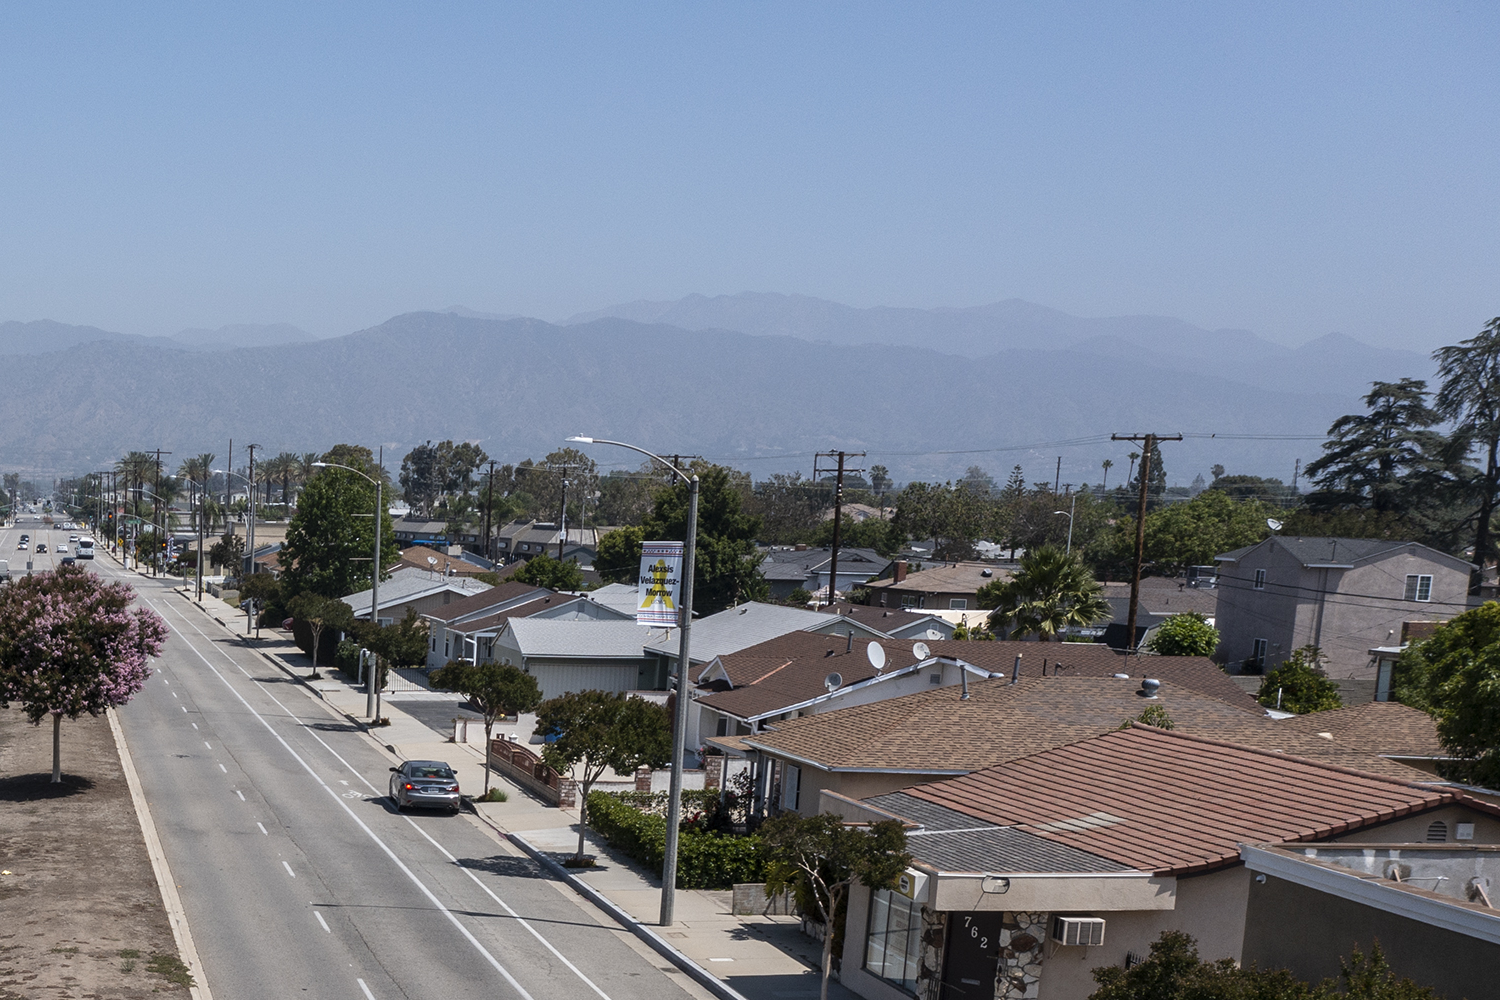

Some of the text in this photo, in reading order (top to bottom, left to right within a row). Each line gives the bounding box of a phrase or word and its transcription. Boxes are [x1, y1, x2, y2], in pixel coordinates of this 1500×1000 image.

[648, 564, 674, 574] Alexsis
[640, 575, 680, 587] Velazquez-
[645, 588, 673, 598] Morrow
[964, 916, 988, 949] 762
